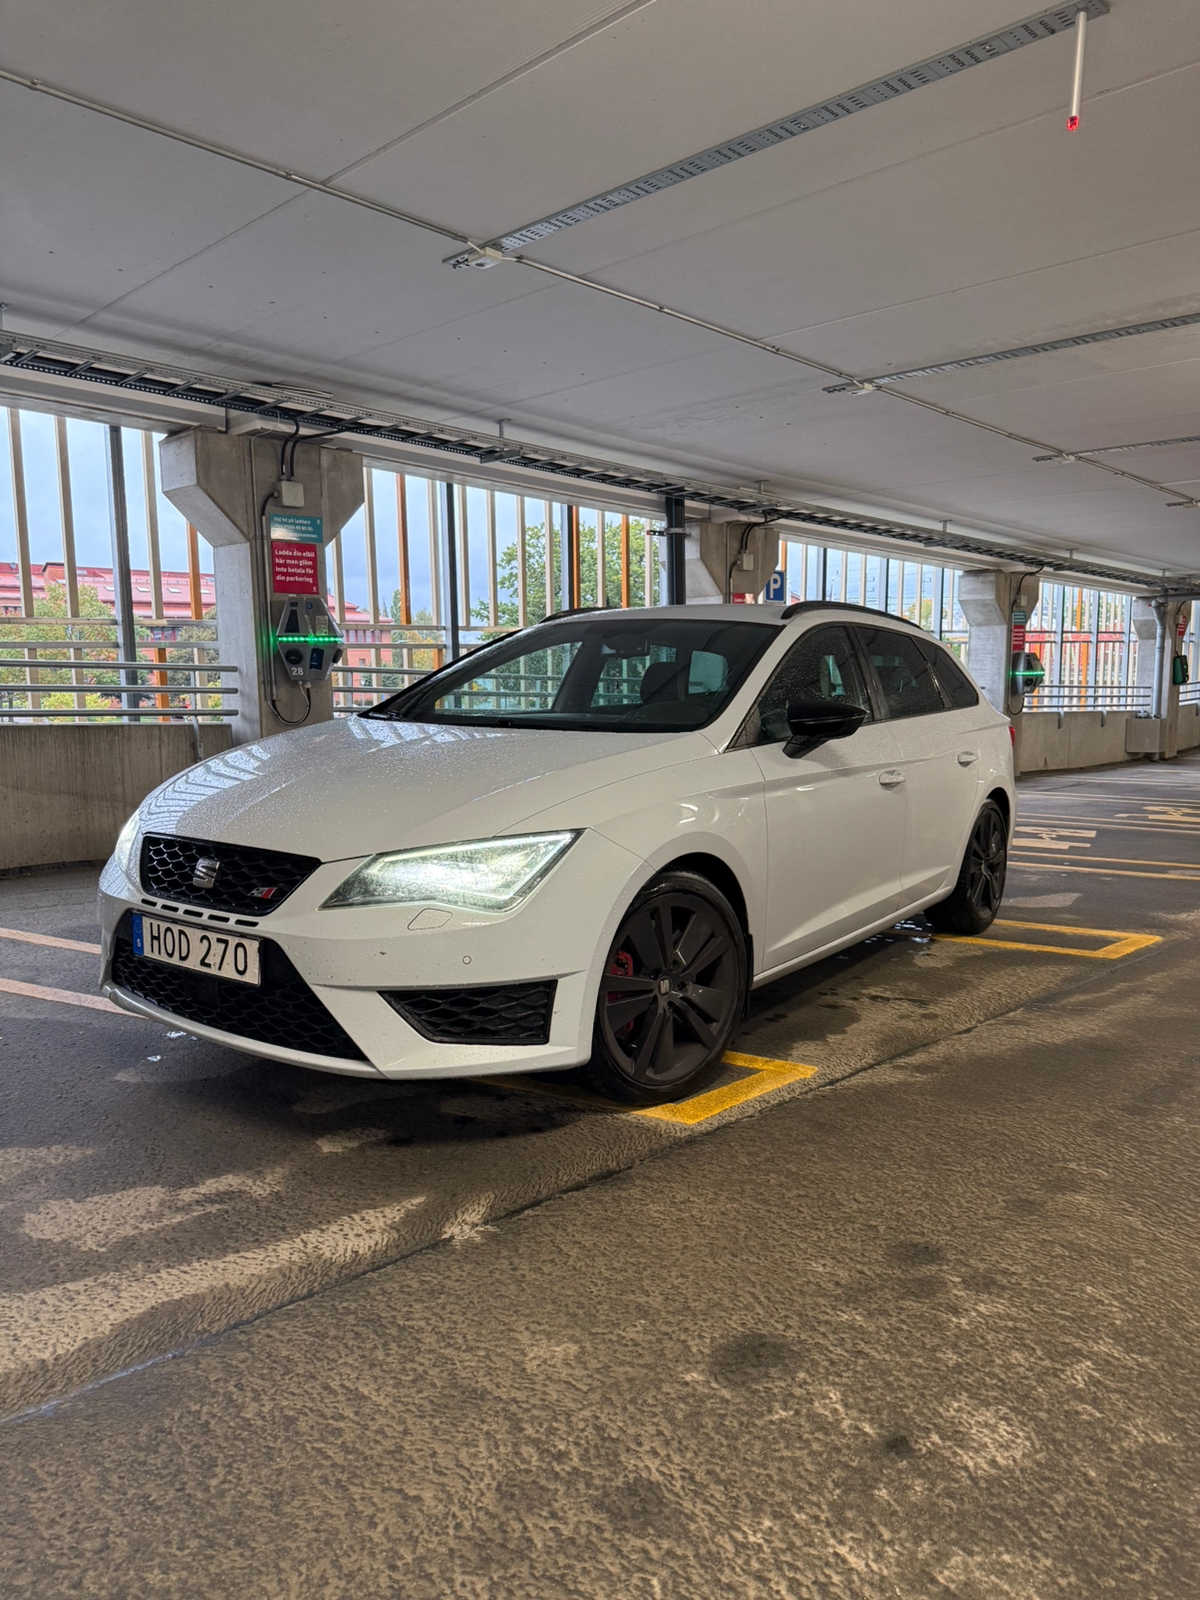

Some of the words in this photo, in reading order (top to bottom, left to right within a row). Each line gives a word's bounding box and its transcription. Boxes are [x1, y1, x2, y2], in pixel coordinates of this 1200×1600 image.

[770, 573, 781, 598] P
[292, 667, 304, 676] 28
[150, 922, 190, 962] HOD
[200, 934, 248, 976] 270
